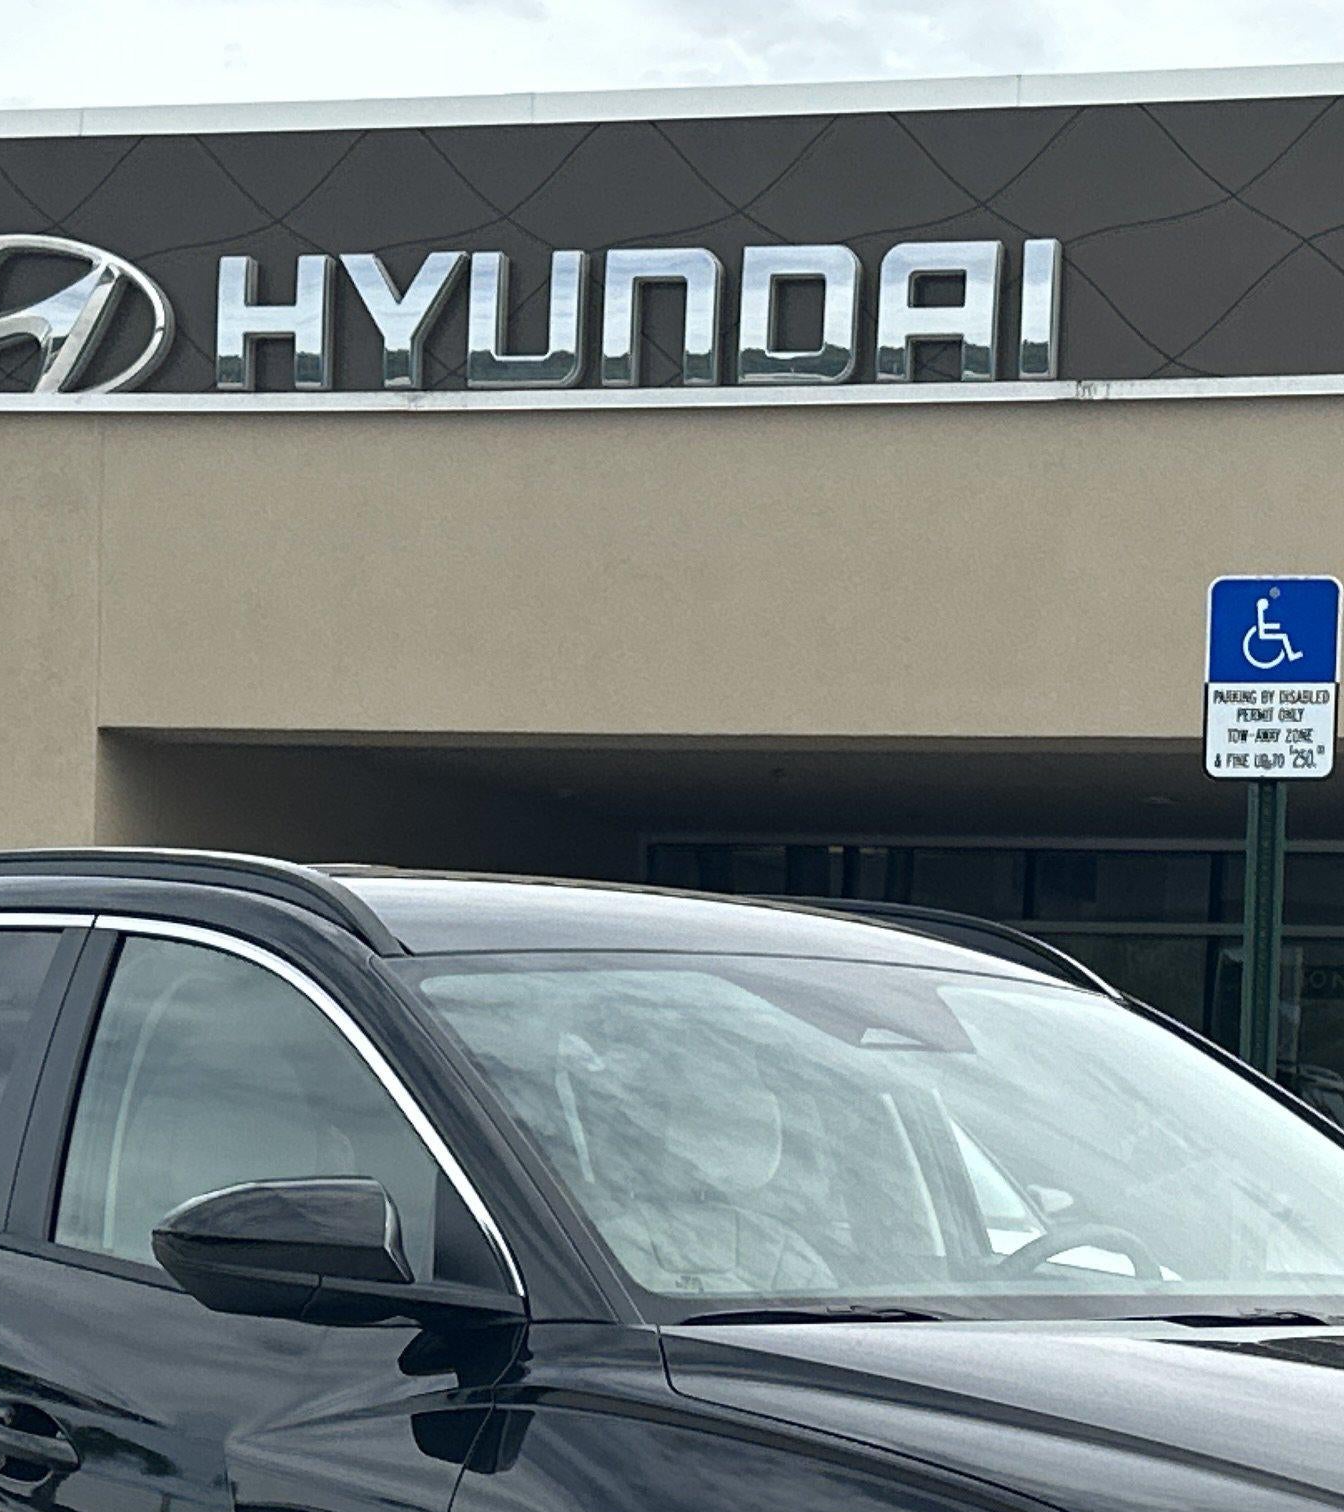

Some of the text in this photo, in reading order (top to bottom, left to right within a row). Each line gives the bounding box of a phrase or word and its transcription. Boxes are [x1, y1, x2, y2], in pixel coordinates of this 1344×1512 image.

[215, 238, 1063, 390] HYUNDAI
[1213, 690, 1330, 704] PARKING BY DISABLED
[1236, 707, 1305, 722] PERMIT ONLY
[1285, 728, 1314, 743] ZONE
